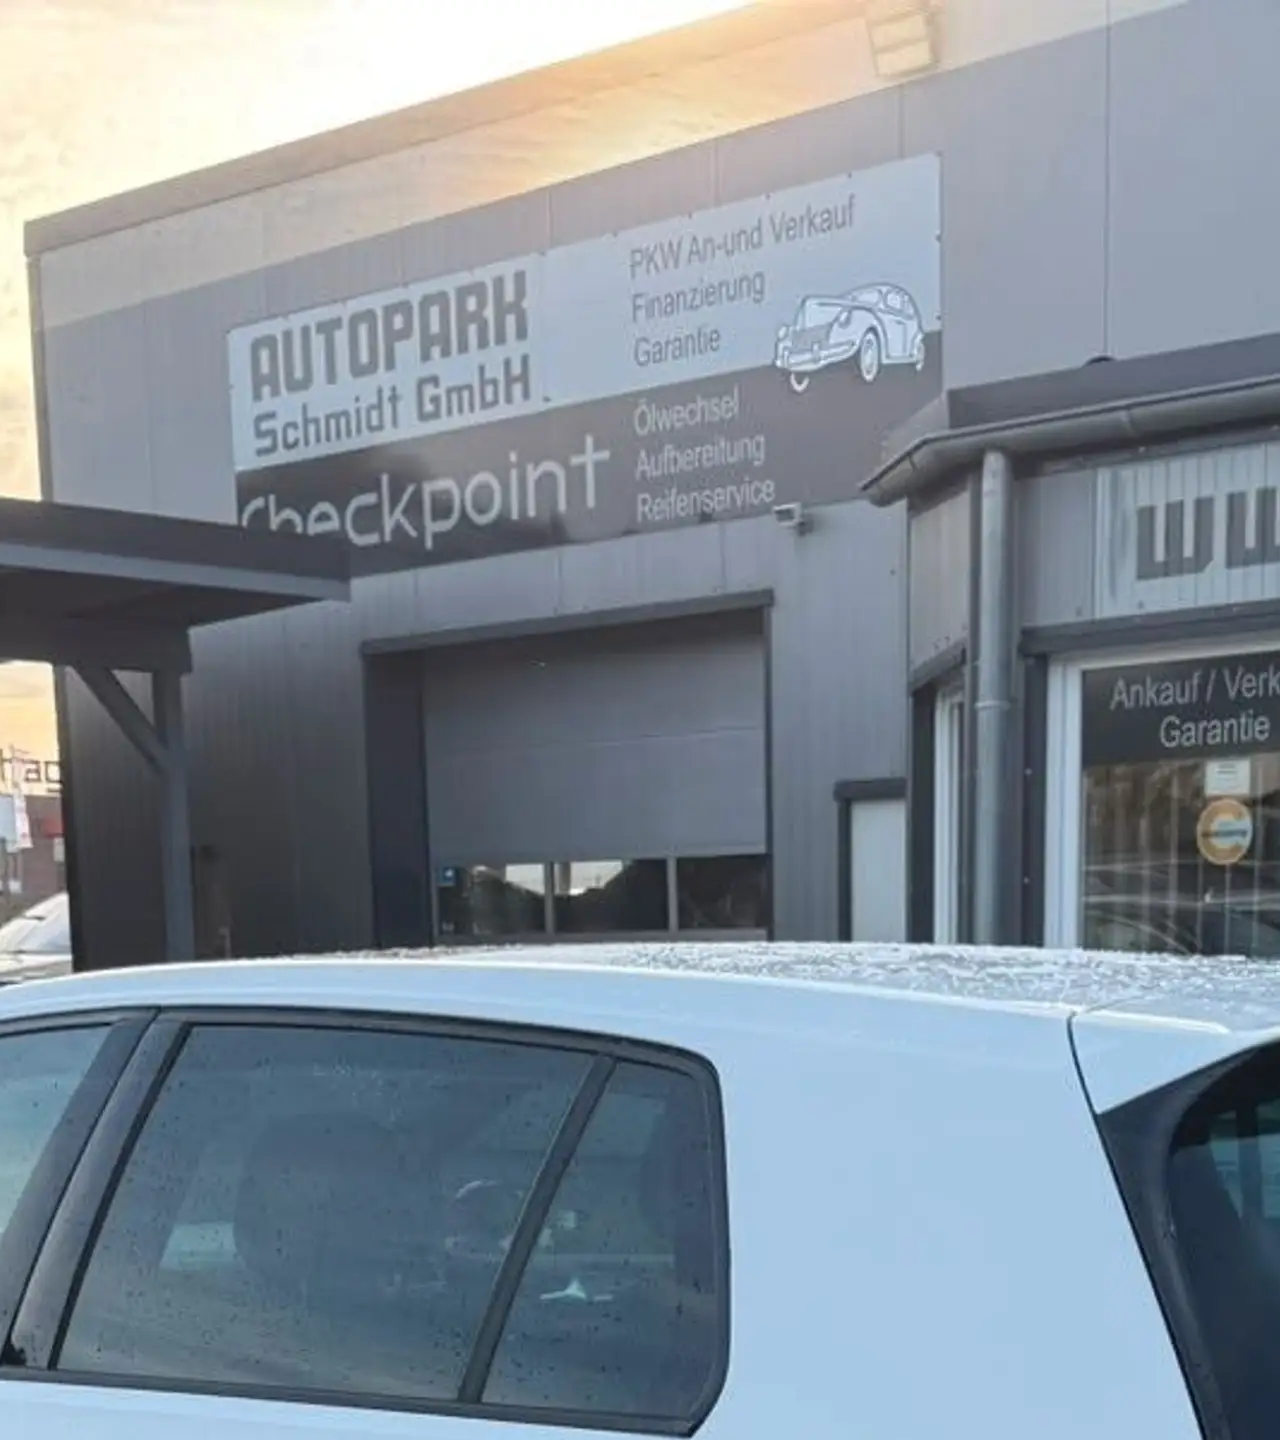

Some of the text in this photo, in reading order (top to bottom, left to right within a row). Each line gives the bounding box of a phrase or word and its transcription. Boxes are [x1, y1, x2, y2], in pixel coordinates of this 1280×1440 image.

[629, 194, 856, 280] PKW An-und Verkauf
[631, 271, 765, 323] Finanzierung
[250, 269, 529, 402] AUTOPARK
[633, 328, 721, 367] Garantie
[253, 353, 531, 457] Schmidt GmbH
[634, 383, 740, 436] Ölwechsel
[636, 435, 766, 481] Aufbereitung
[637, 476, 775, 523] Reifenservice
[1110, 668, 1202, 710] Ankauf
[1160, 710, 1271, 748] Garantie
